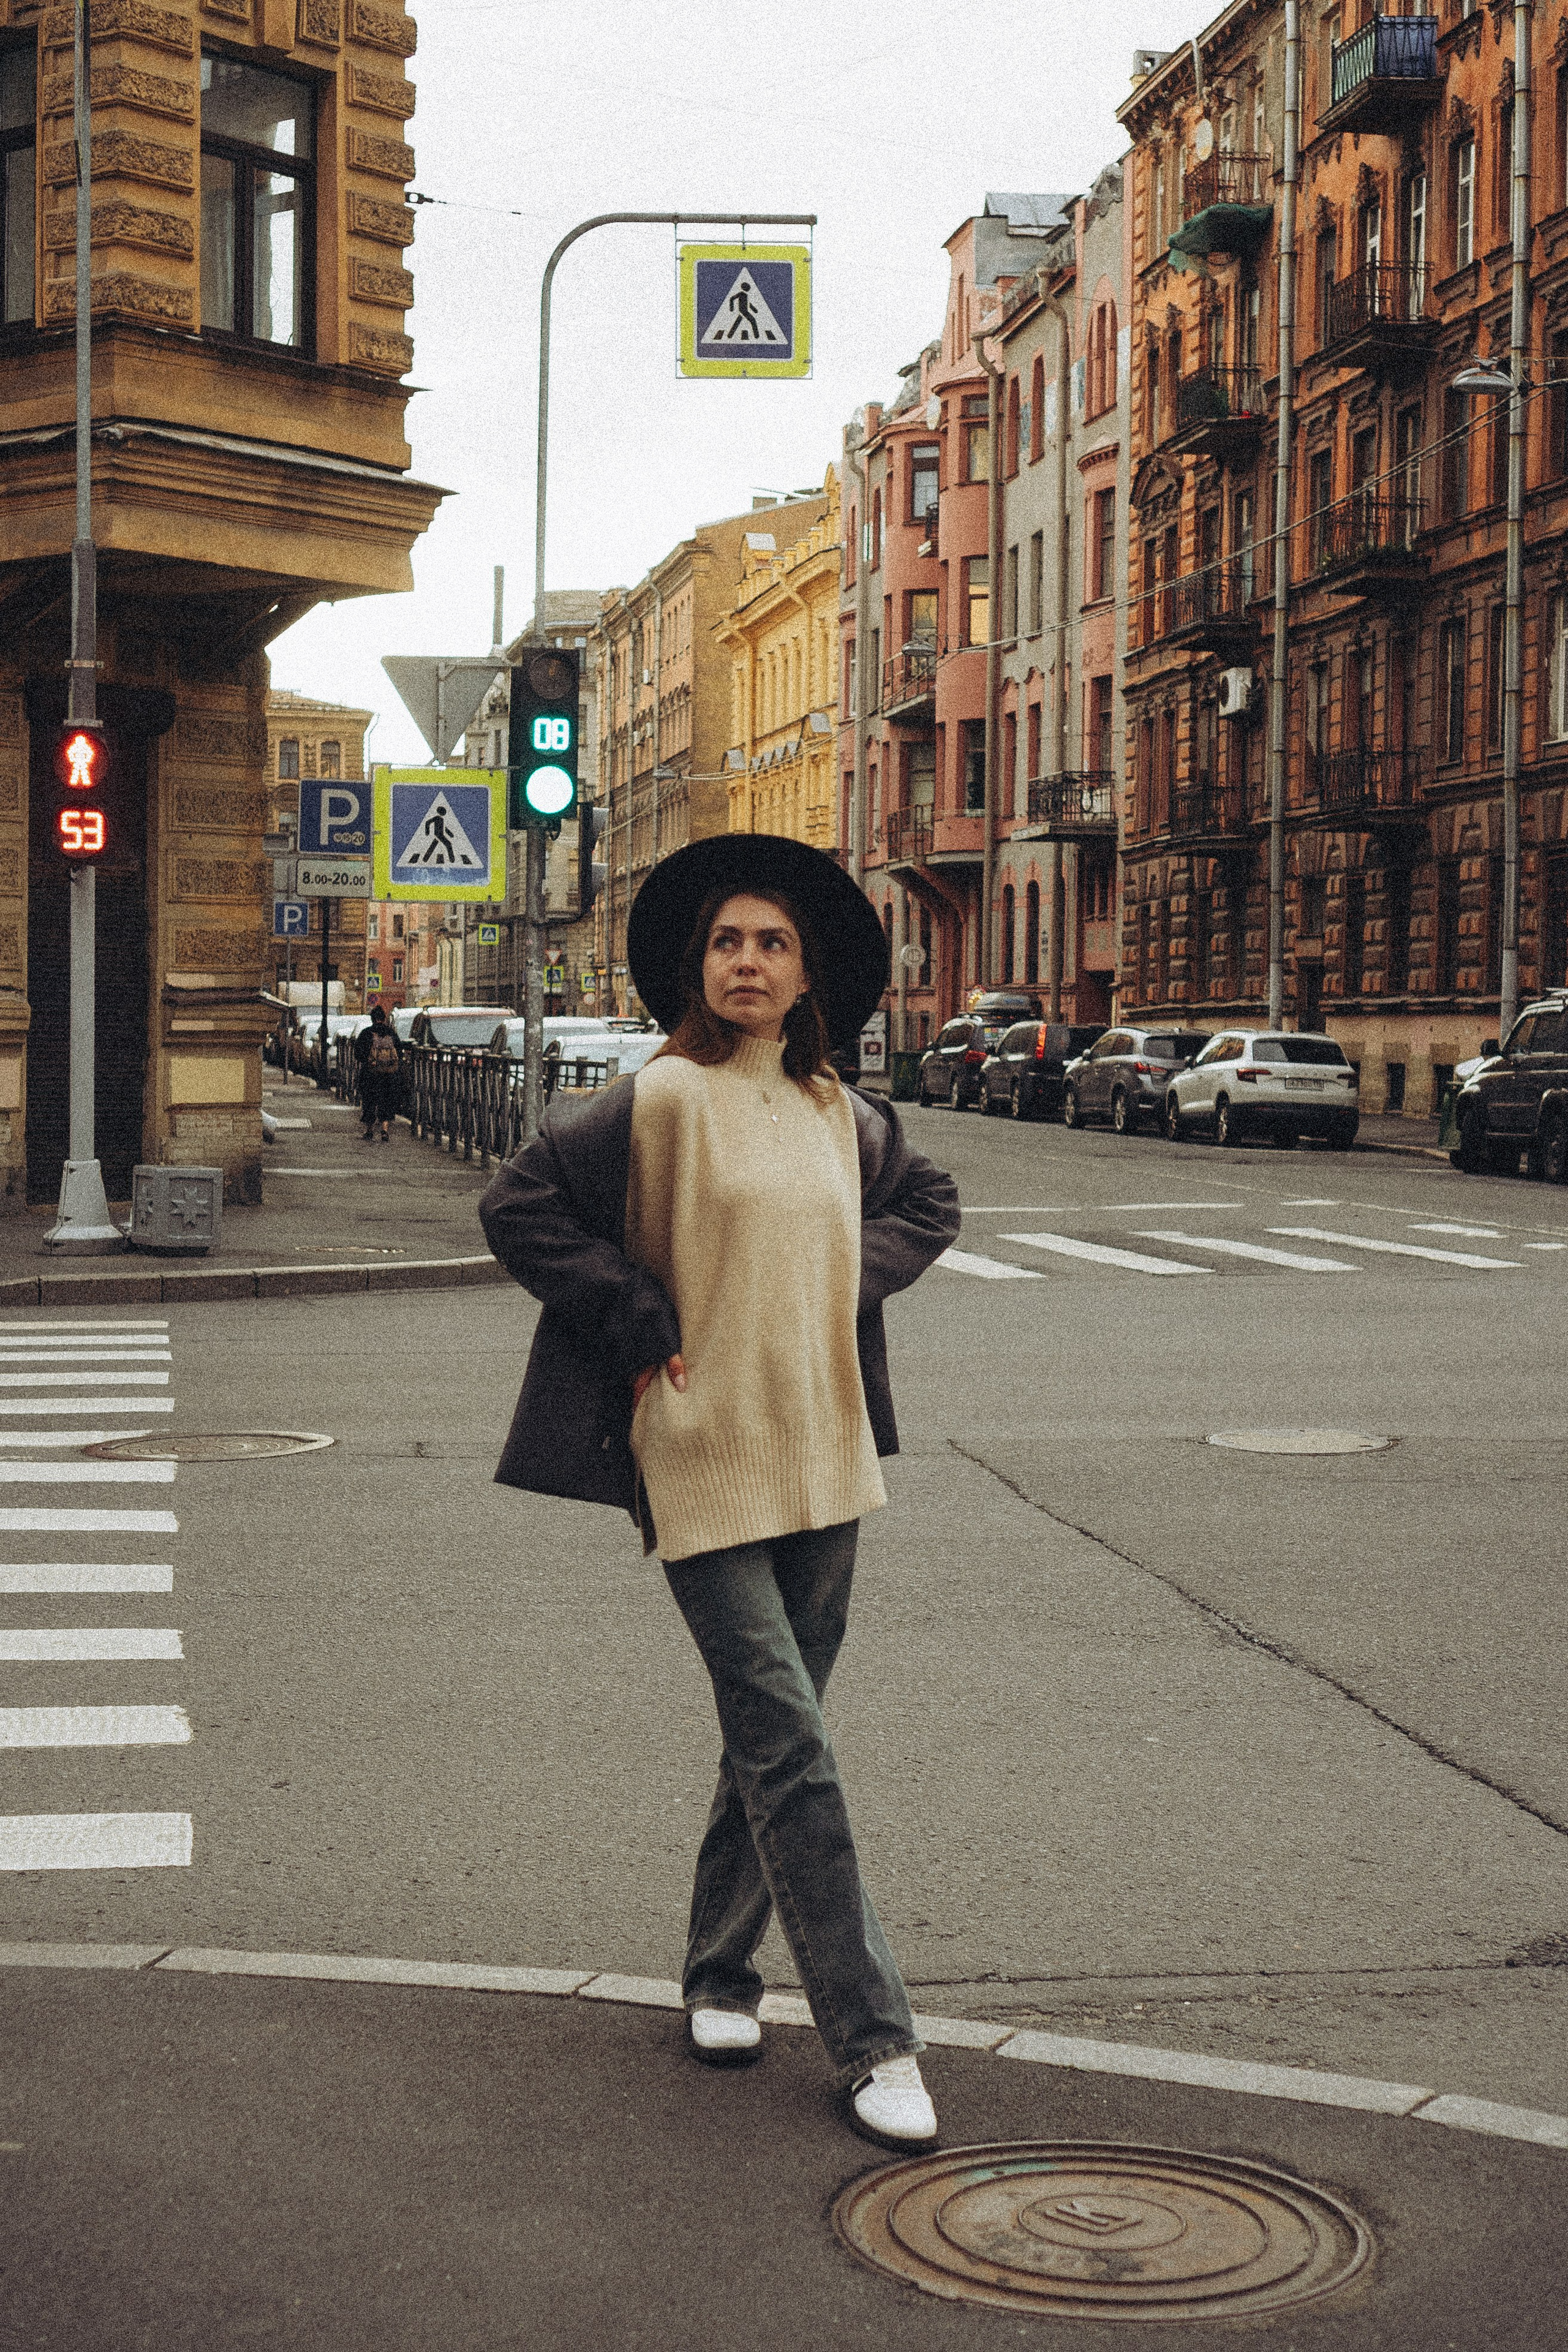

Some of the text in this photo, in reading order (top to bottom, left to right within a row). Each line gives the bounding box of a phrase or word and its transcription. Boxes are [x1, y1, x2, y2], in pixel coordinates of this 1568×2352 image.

[533, 717, 570, 751] 08
[60, 810, 105, 851] 53
[320, 788, 360, 846] P
[353, 834, 364, 843] 20
[302, 871, 366, 886] 8.00-20.00
[284, 905, 302, 933] P
